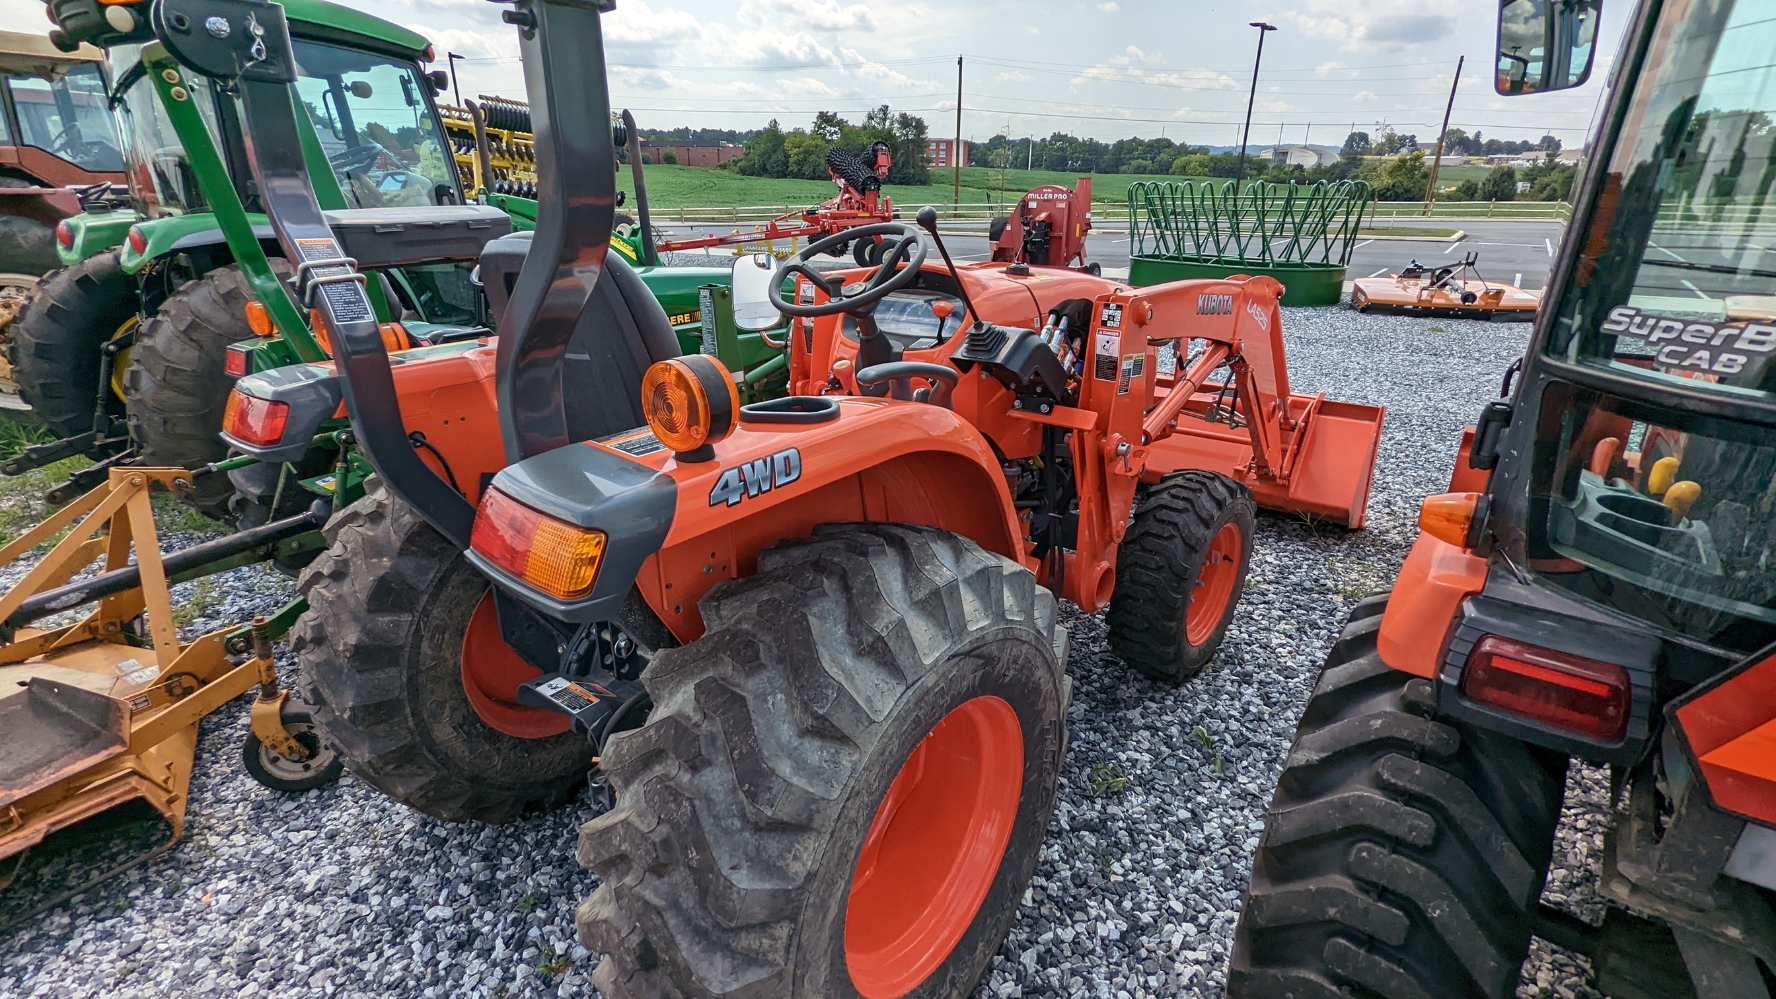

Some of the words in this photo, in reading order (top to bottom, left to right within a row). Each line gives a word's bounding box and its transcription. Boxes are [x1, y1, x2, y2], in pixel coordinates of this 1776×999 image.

[670, 313, 691, 325] ERE
[1197, 293, 1233, 315] KUBOTA
[1246, 299, 1268, 331] LA525
[1603, 307, 1776, 352] SuperB
[1657, 345, 1748, 374] CAB
[709, 447, 801, 507] 4WD
